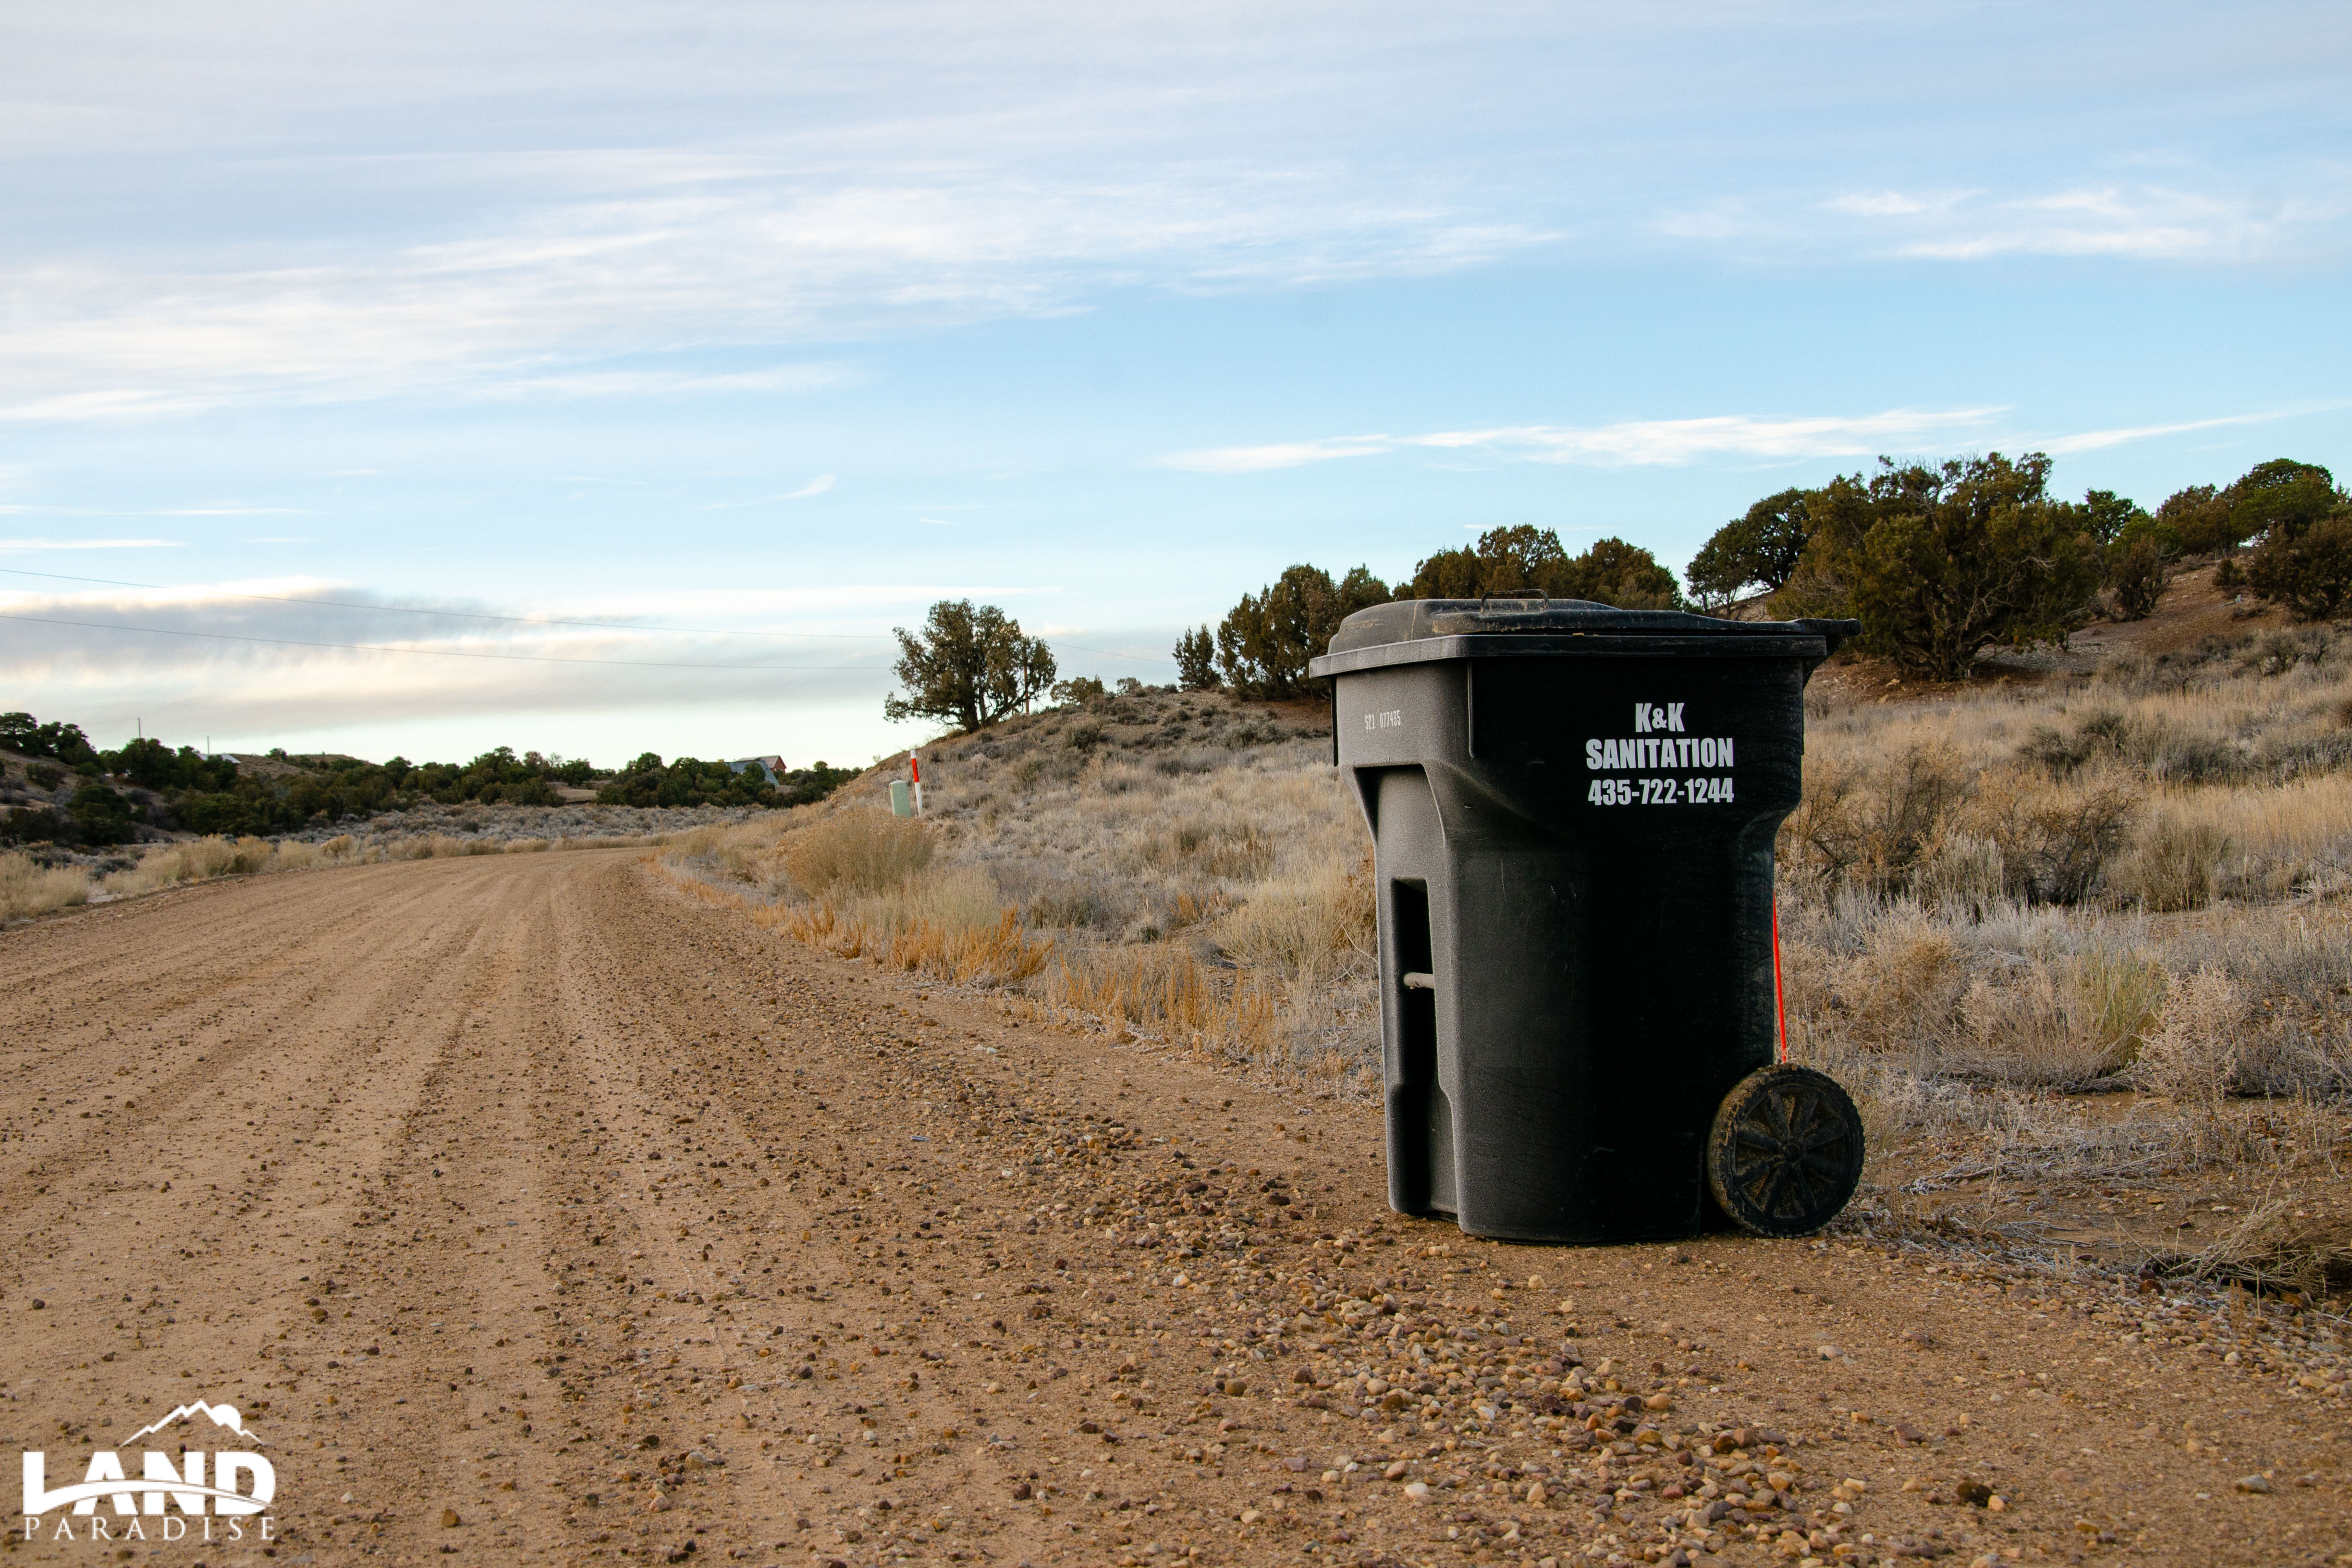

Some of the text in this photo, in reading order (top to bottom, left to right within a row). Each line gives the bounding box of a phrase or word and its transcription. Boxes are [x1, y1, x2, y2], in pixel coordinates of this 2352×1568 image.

[1380, 709, 1401, 728] 077435
[1635, 702, 1685, 733] K&K
[1586, 737, 1734, 770] SANITATION
[1588, 777, 1734, 806] 435-722-1244
